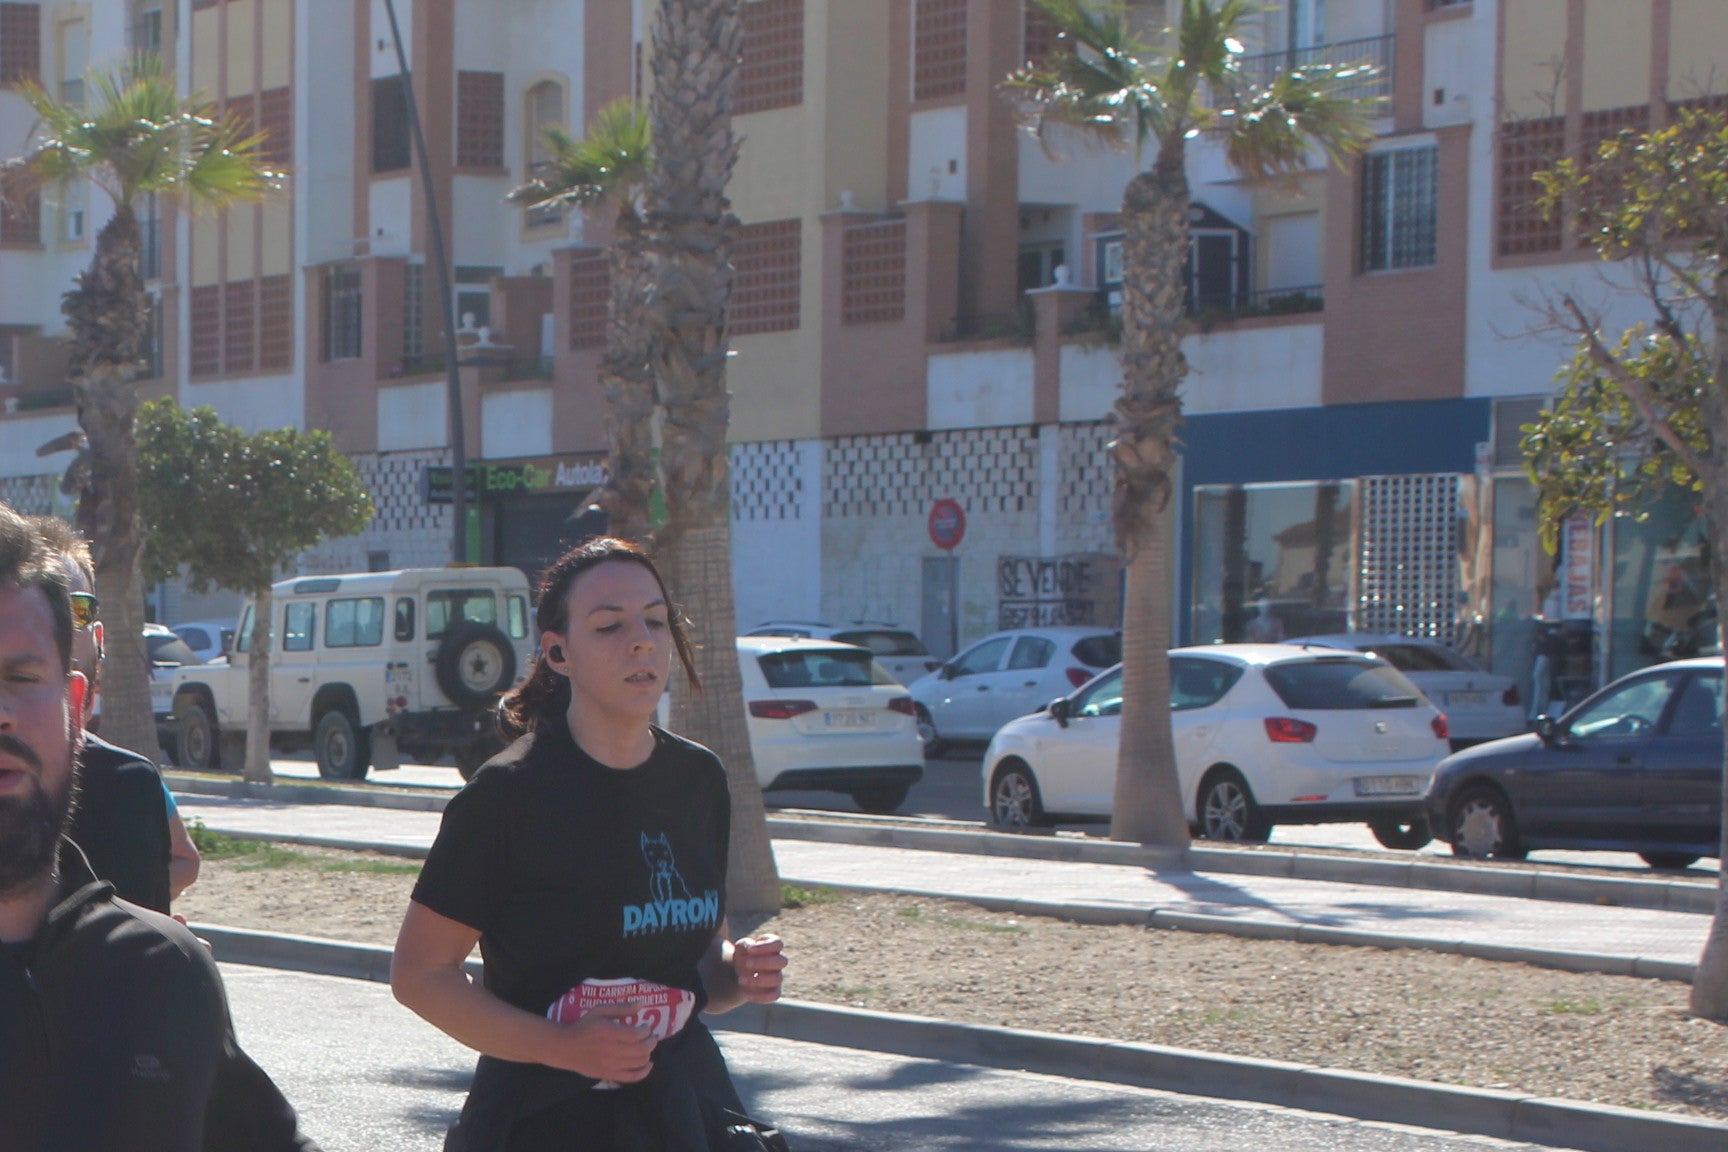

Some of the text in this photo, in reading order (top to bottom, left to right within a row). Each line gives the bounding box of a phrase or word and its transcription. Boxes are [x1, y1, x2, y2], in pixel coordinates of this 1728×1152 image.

[1001, 559, 1091, 596] SE VENDE
[623, 896, 719, 932] DAYRON
[581, 985, 597, 997] VIII
[599, 984, 637, 997] CARRERA
